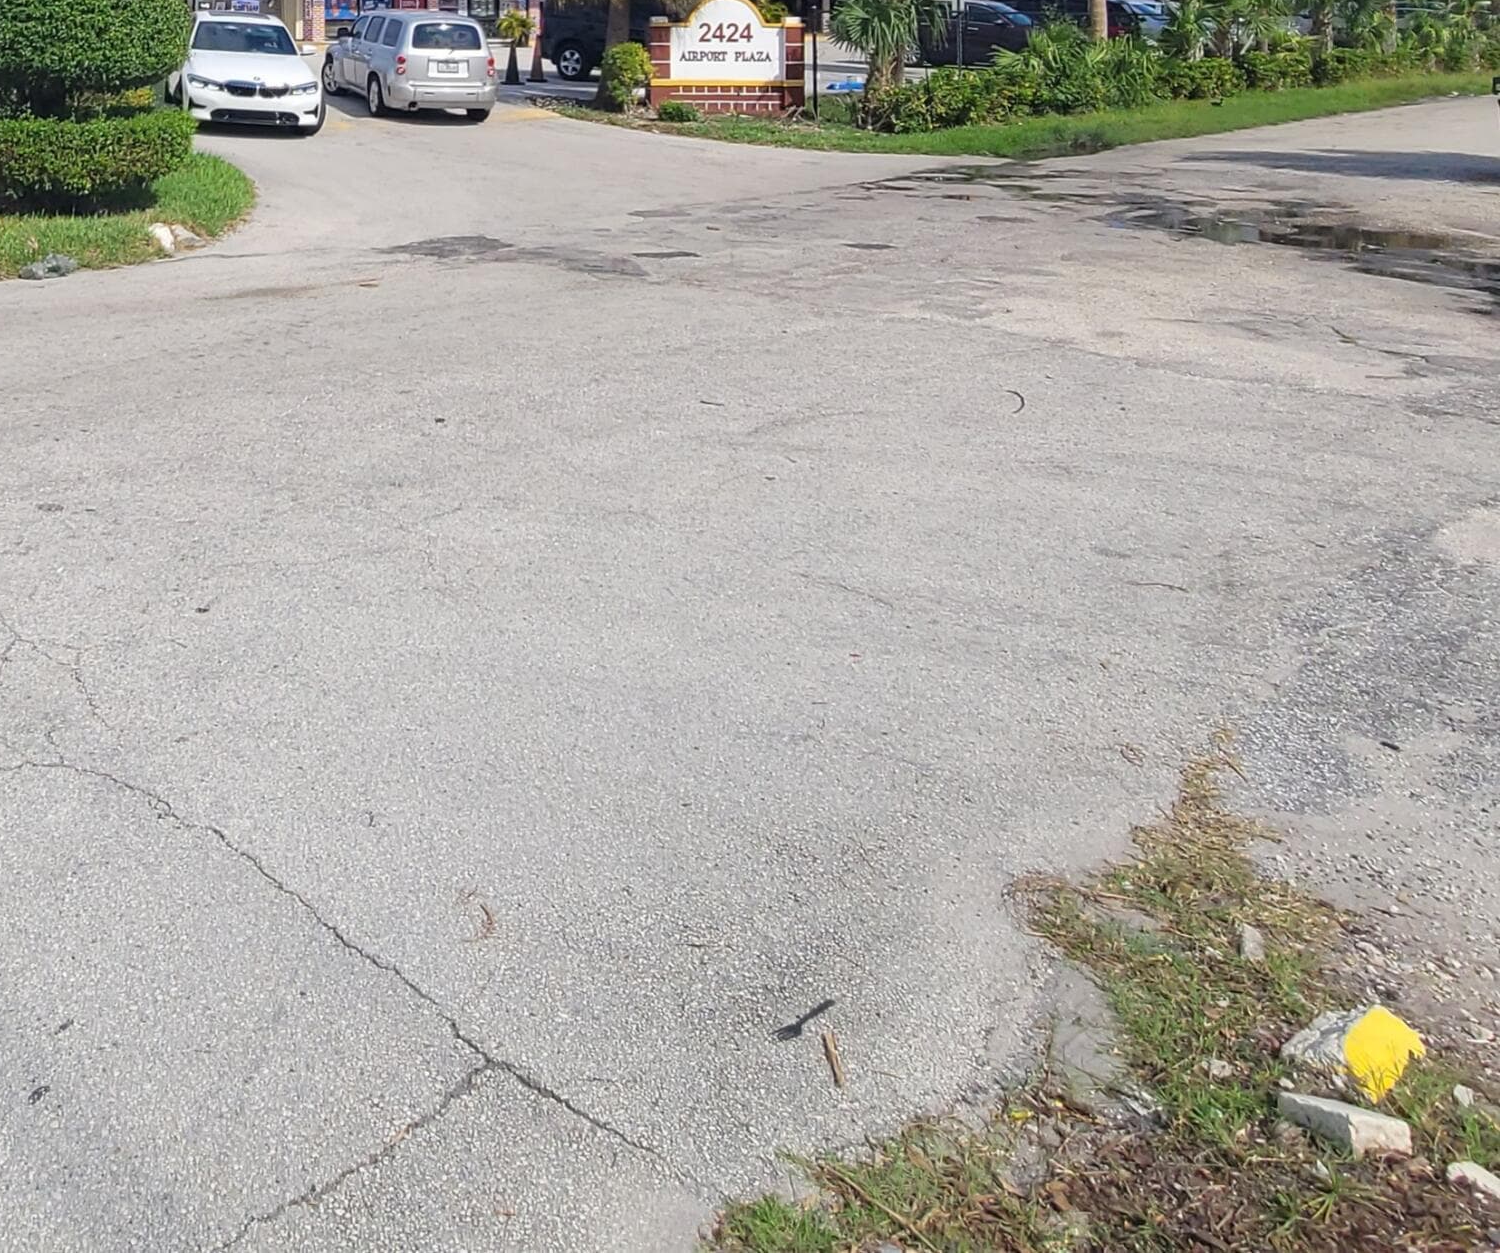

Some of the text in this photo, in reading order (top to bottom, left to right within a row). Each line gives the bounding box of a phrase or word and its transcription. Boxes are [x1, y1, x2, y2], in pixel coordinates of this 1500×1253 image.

[698, 22, 754, 43] 2424
[679, 50, 772, 63] AIRPORT PLAZA
